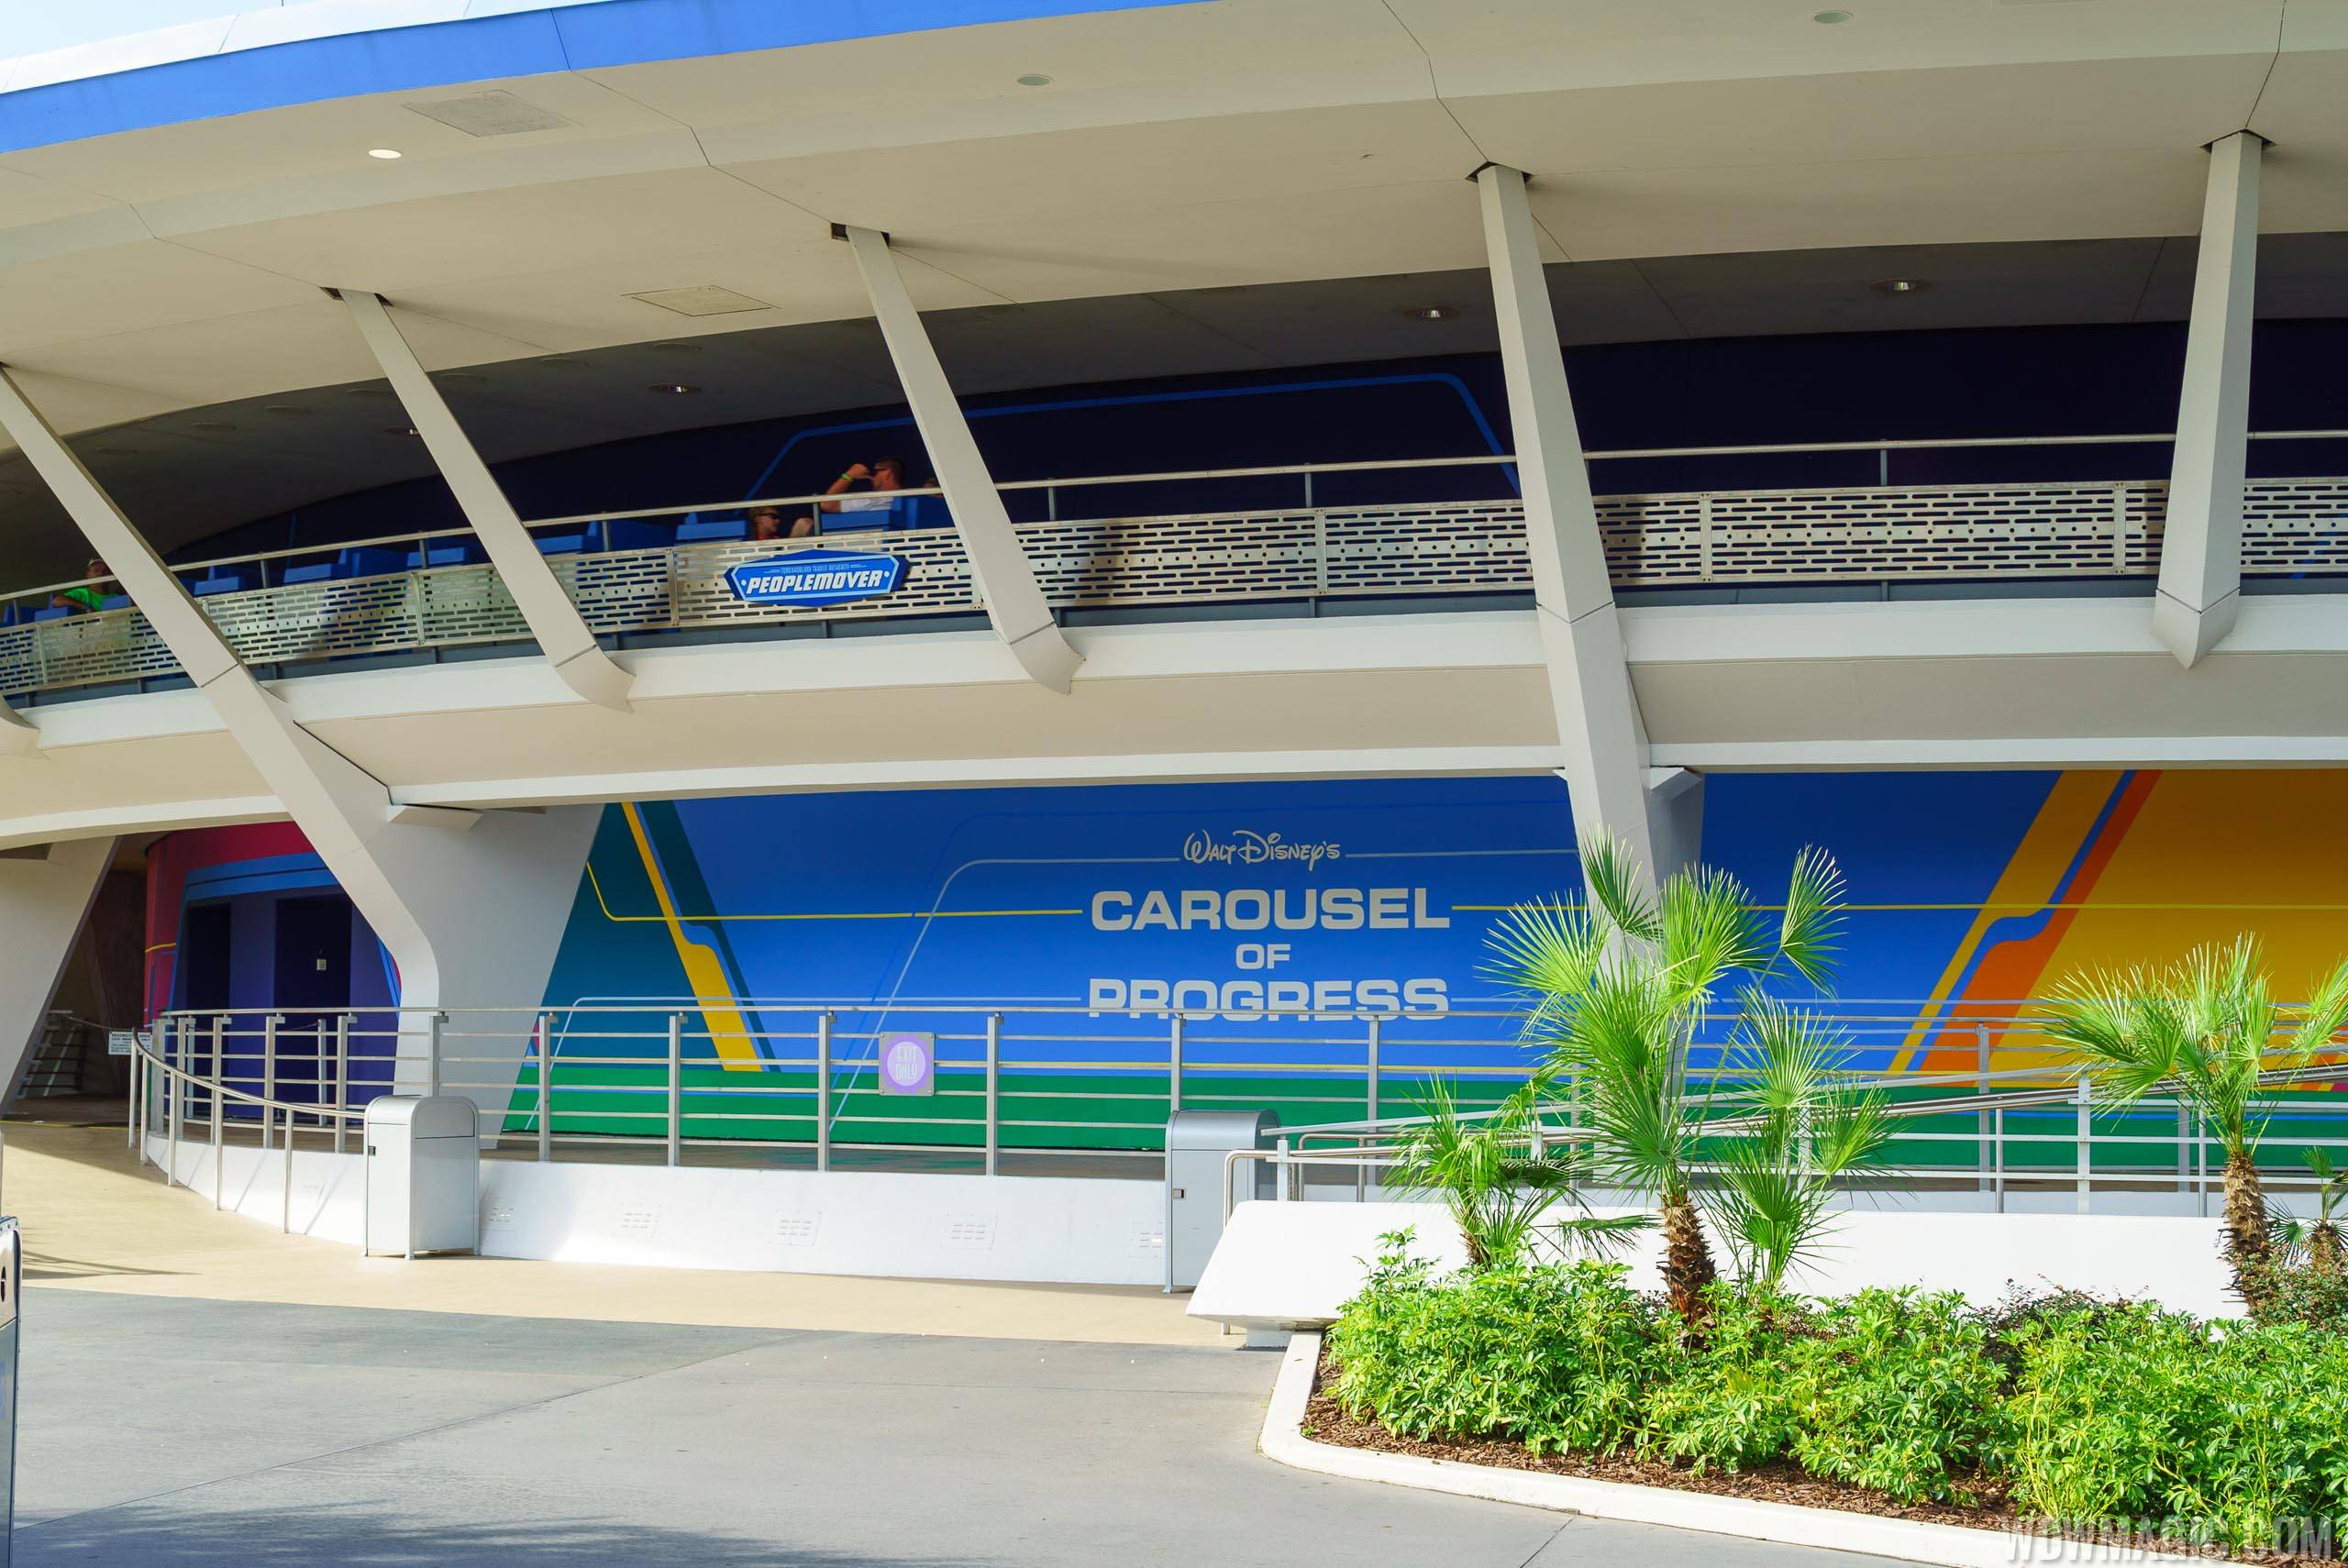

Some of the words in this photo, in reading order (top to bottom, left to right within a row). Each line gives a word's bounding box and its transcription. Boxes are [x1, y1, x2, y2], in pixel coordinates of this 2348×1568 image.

[747, 569, 883, 594] PEOPLEMOVER
[1091, 888, 1450, 931] CAROUSEL
[1235, 944, 1290, 969] OF
[1089, 978, 1449, 1021] PROGRESS
[896, 1045, 917, 1063] EXIT
[895, 1063, 918, 1080] ONLY
